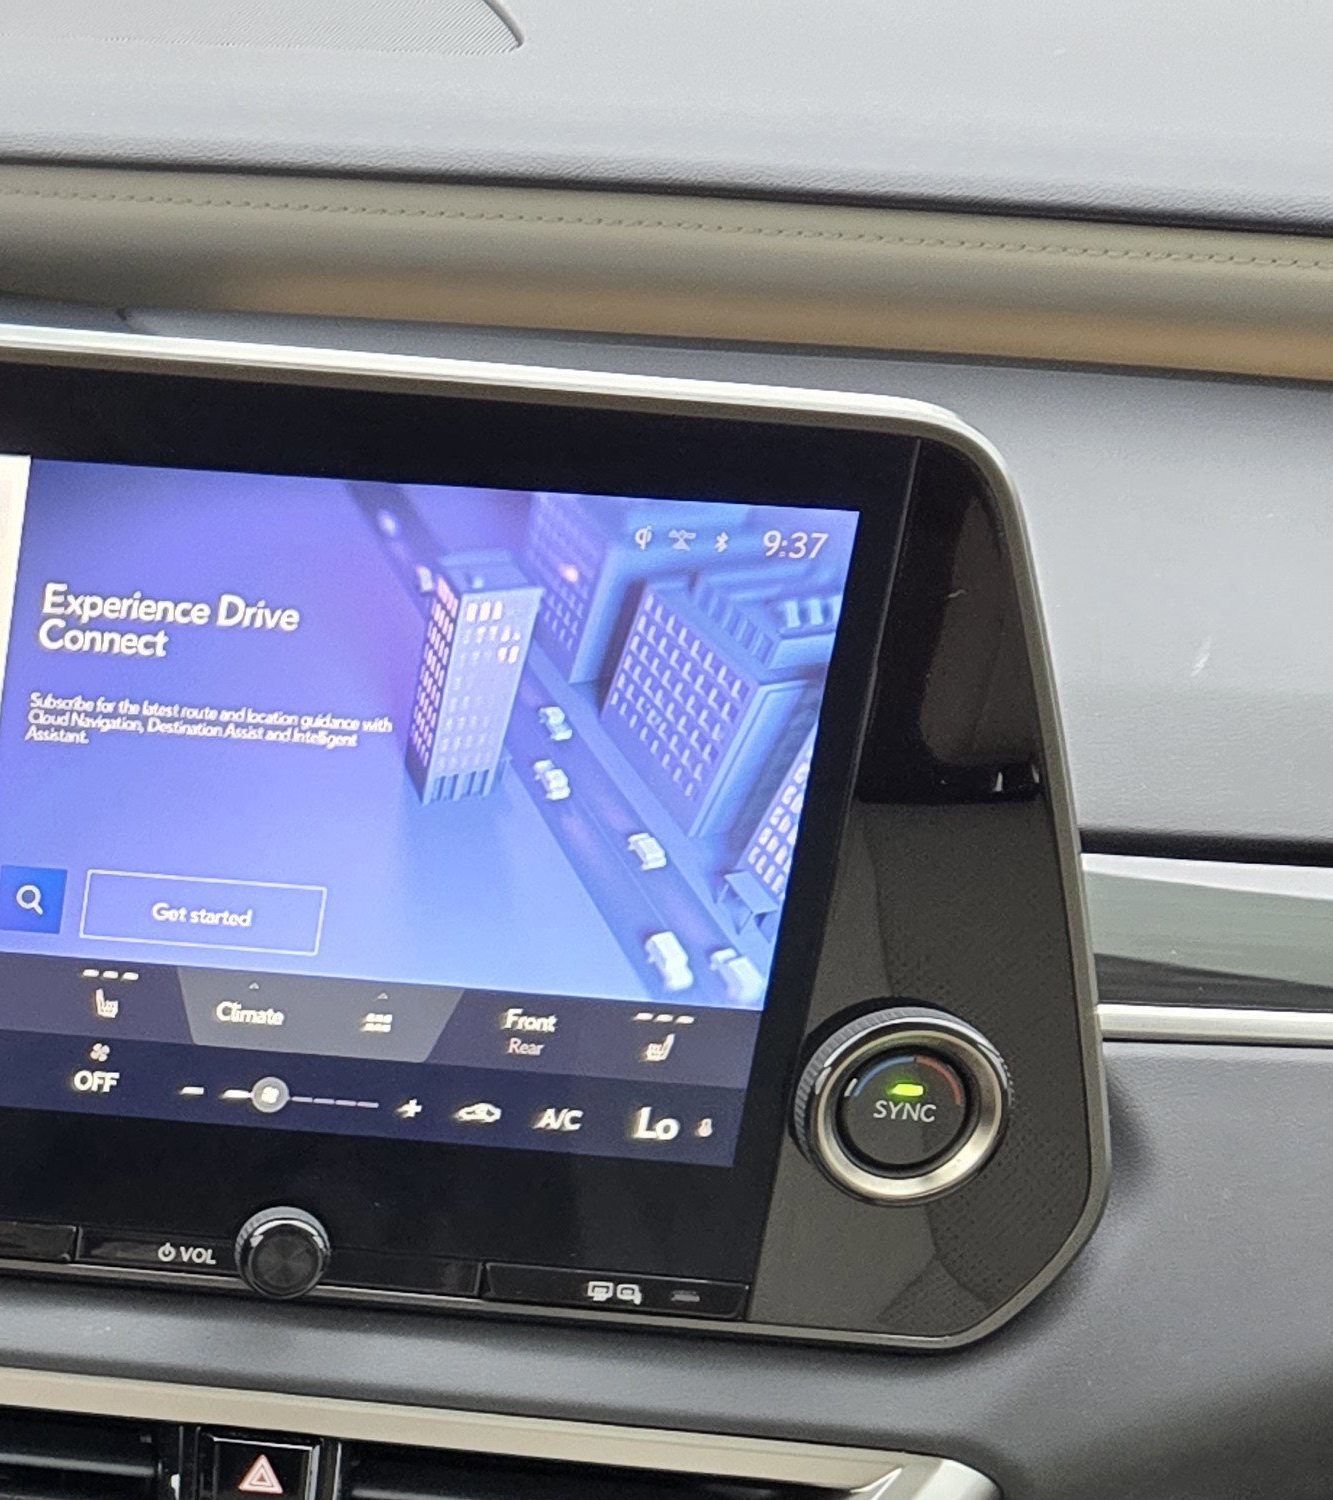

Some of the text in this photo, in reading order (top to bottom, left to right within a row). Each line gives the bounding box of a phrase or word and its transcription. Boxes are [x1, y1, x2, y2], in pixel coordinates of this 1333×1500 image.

[763, 530, 829, 559] 9:37
[42, 582, 300, 631] Experience Drive
[39, 618, 169, 657] Connect
[30, 692, 393, 733] Subscribe for the latest route and location guidance with
[28, 709, 358, 749] Cloud Navigation, Destination Assist and Intelligent
[151, 902, 253, 927] Get started
[215, 1001, 284, 1026] Climate
[502, 1008, 558, 1033] Front
[507, 1037, 544, 1056] Rear
[73, 1070, 120, 1093] OFF
[534, 1108, 584, 1131] A/C
[632, 1106, 680, 1141] Lo
[873, 1100, 937, 1123] SYNC
[180, 1247, 216, 1265] VOL
